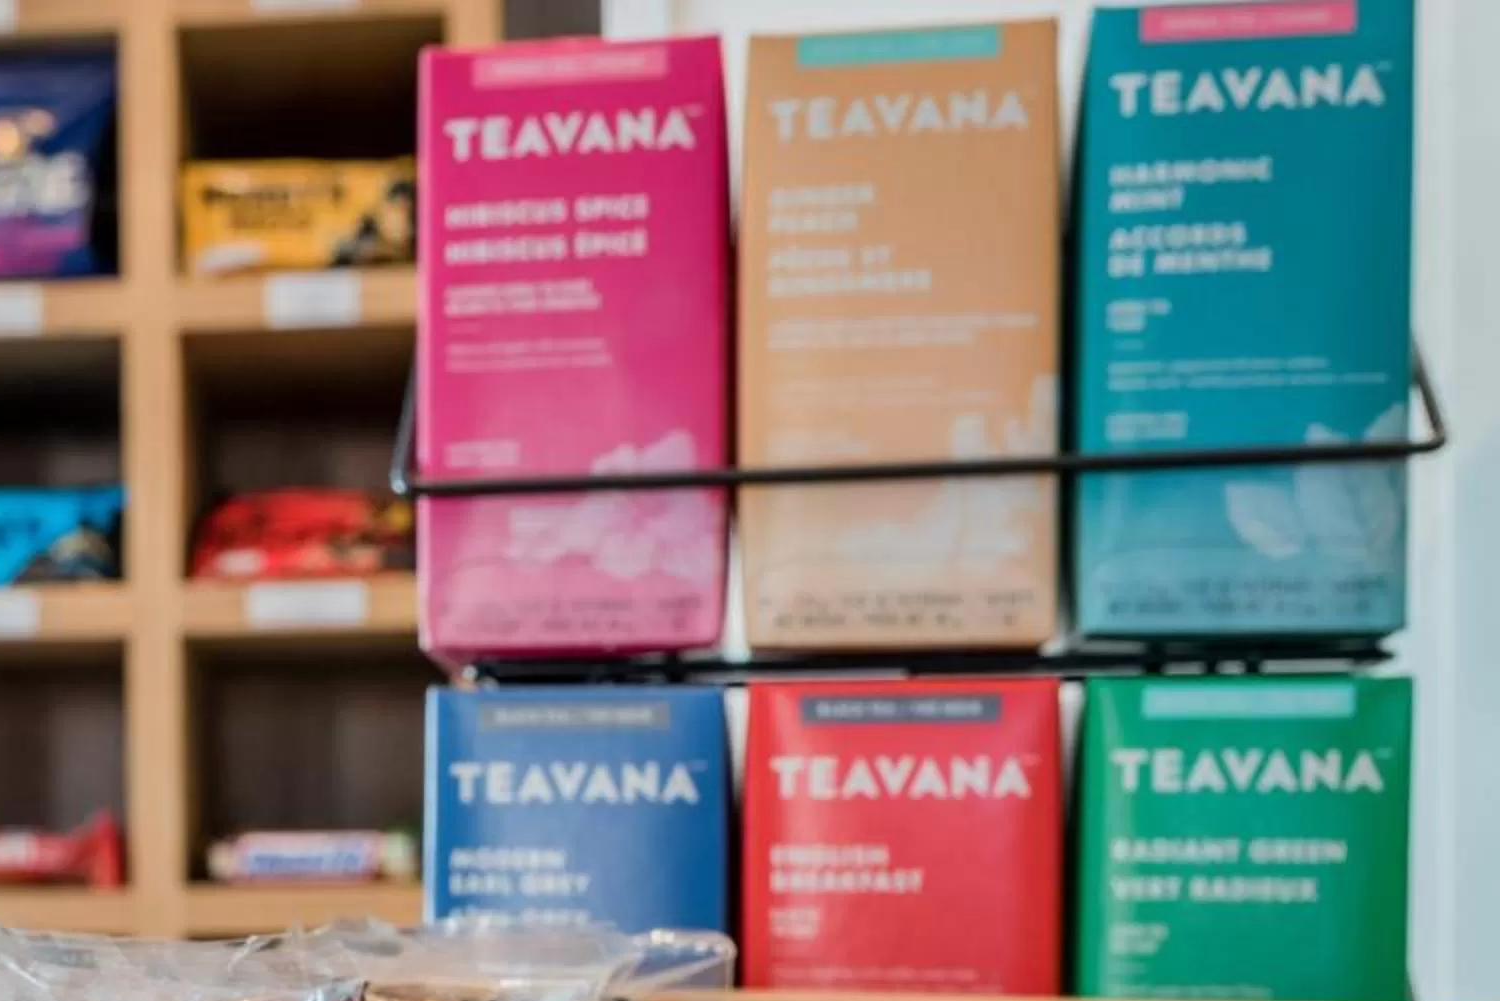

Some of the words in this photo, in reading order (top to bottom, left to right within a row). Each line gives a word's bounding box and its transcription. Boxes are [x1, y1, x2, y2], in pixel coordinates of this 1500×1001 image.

[769, 90, 1031, 141] TEAVANA
[1111, 63, 1387, 118] TEAVANA
[443, 105, 697, 162] TEAVANA
[449, 760, 700, 805] TEAVANA
[769, 752, 1031, 801] TEAVANA
[1110, 747, 1385, 794] TEAVANA
